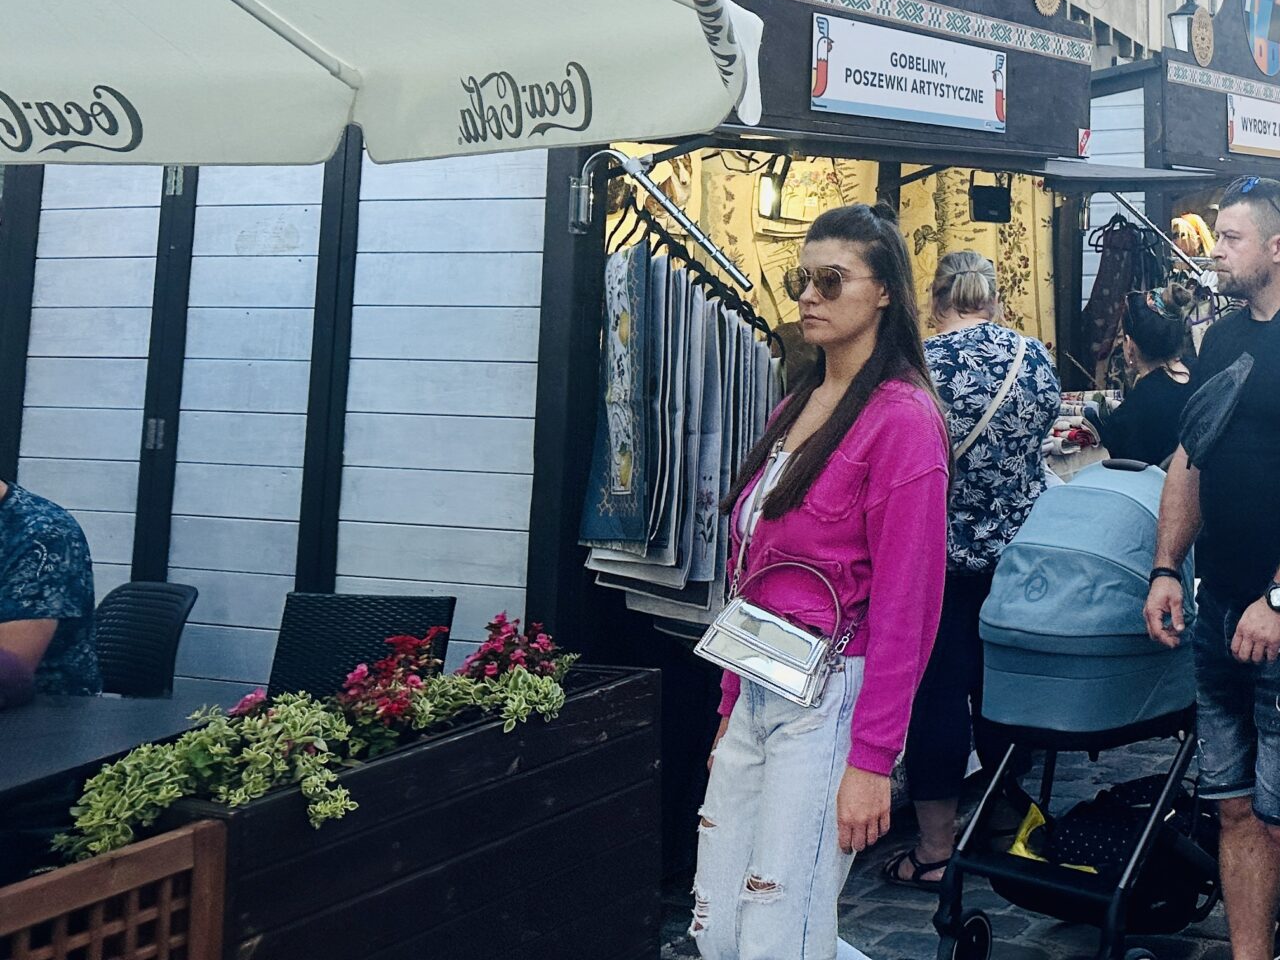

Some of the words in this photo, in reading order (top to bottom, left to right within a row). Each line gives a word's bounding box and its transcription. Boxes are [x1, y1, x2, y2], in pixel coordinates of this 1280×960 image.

[890, 51, 948, 78] GOBELINY,
[845, 66, 907, 92] POSZEWKI
[911, 79, 984, 104] ARTYSTYCZNE
[1241, 116, 1271, 136] WYROBY
[1273, 122, 1277, 137] Z
